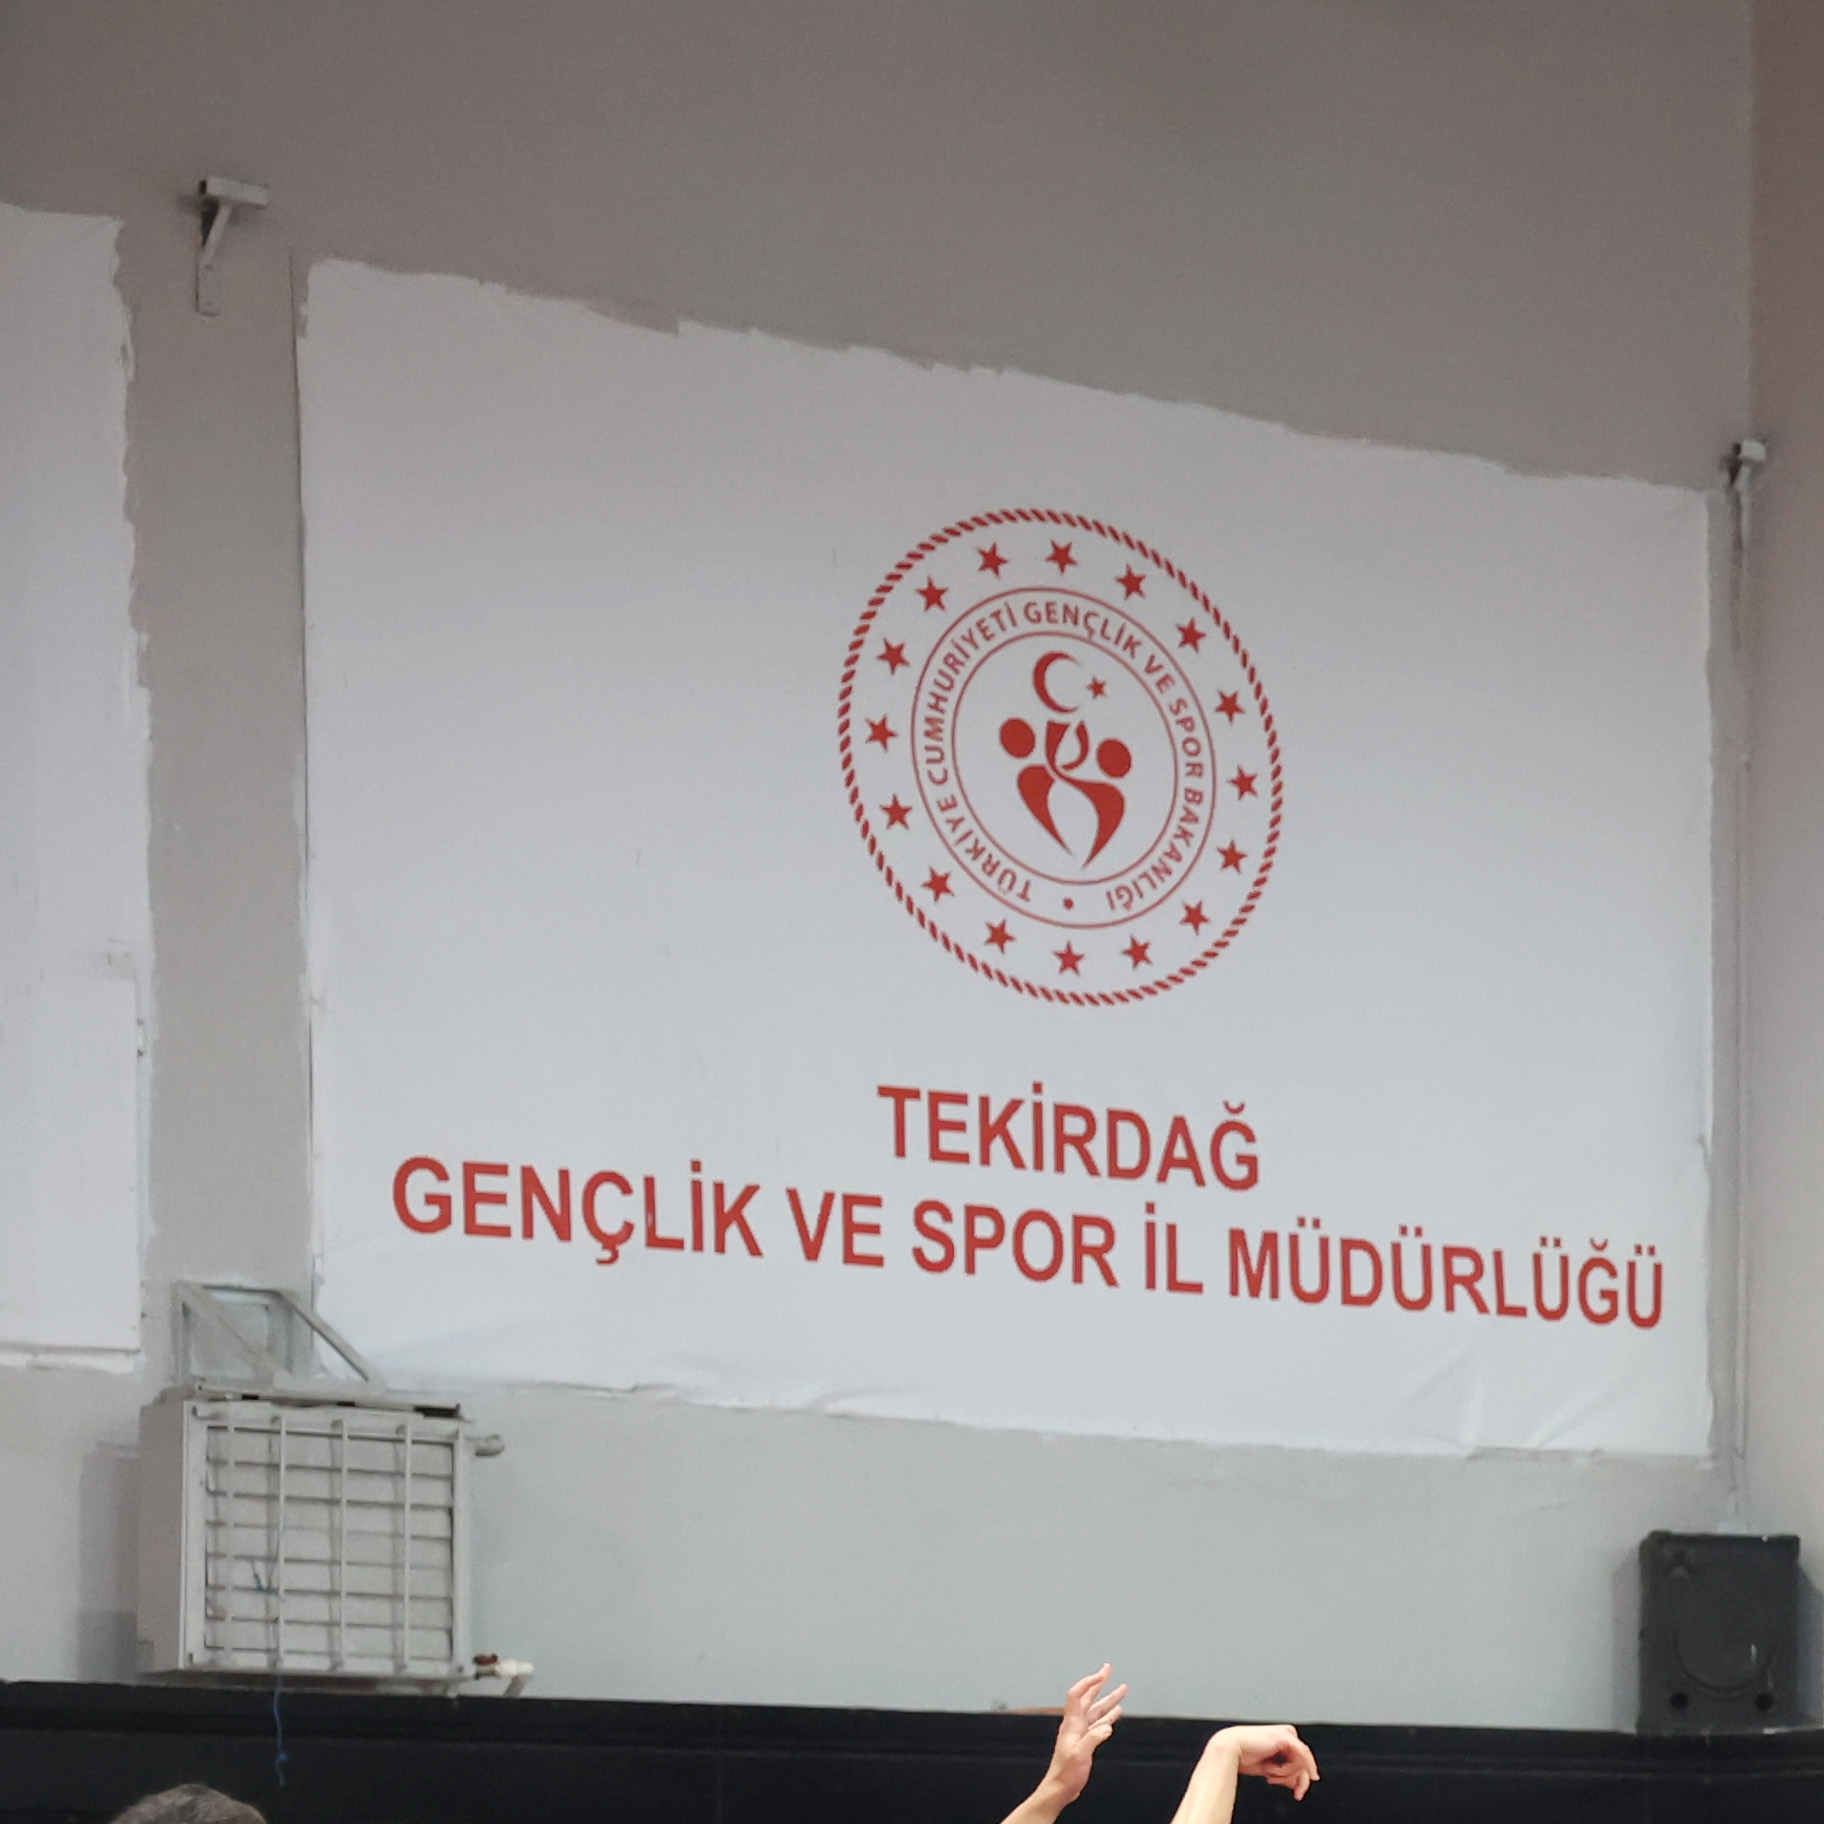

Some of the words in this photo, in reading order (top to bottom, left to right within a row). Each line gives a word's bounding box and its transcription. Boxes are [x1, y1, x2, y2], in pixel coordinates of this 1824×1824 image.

[1023, 600, 1142, 662] GENÇLİK
[1142, 654, 1178, 695] VE
[923, 600, 1019, 788] CUMHURİYETİ
[1168, 695, 1206, 780] SPOR
[934, 793, 1033, 904] TÜRKİYE
[1104, 785, 1206, 913] BAKANLIĞI
[876, 1080, 1260, 1192] TEKİRDAĞ
[391, 1158, 764, 1266] GENÇLİK
[785, 1186, 885, 1268] VE
[911, 1199, 1119, 1289] SPOR
[1144, 1201, 1204, 1295] İL
[1227, 1215, 1663, 1330] MÜDÜRLÜĞÜ
